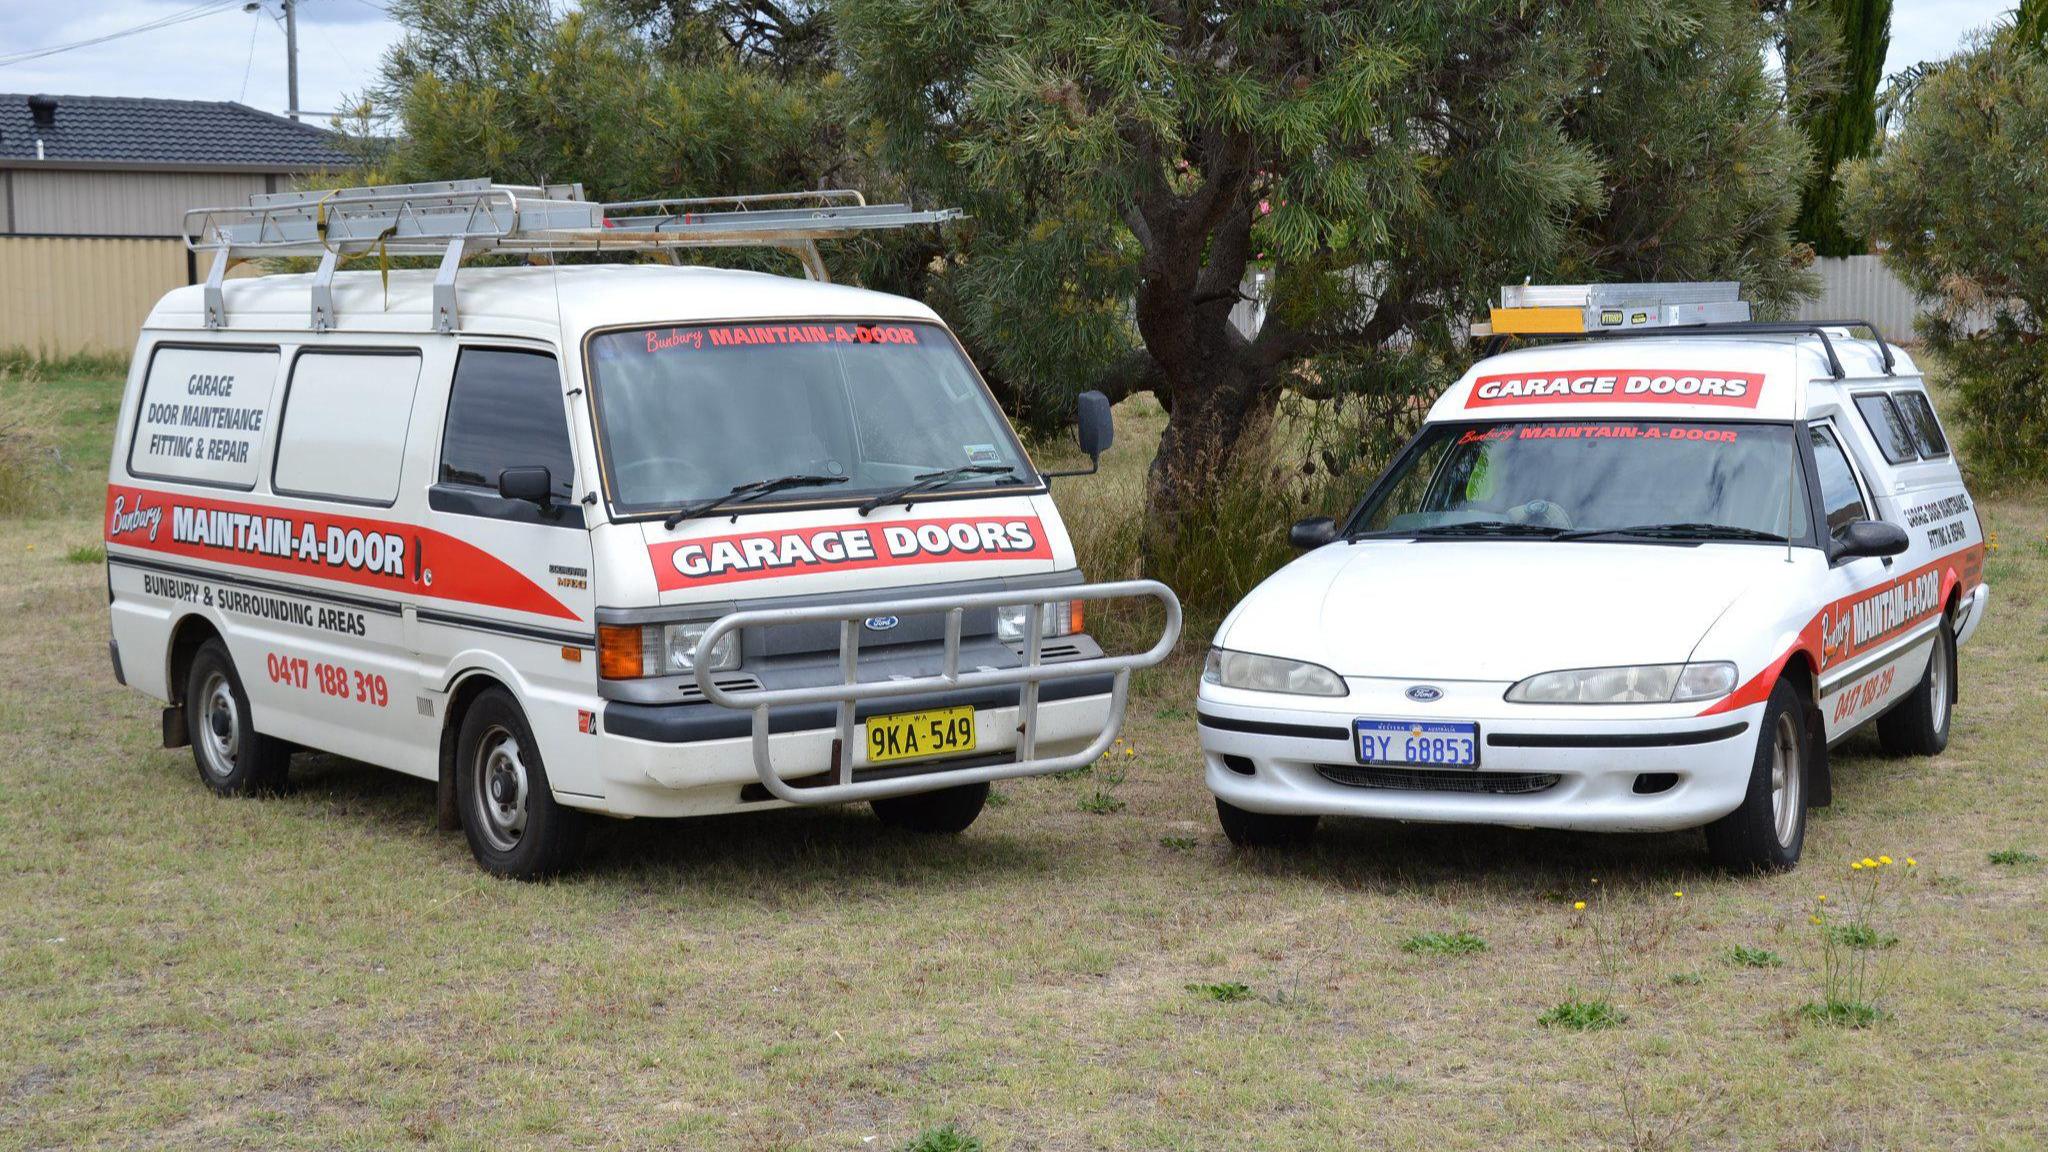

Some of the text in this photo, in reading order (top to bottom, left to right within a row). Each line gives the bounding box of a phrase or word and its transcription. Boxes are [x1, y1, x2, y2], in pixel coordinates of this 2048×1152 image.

[646, 326, 919, 352] Bunbury MAINTAIN-A-DOOR
[187, 374, 235, 398] GARAGE
[1477, 375, 1749, 400] GARAGE DOORS
[147, 402, 263, 432] DOOR MAINTENANCE
[149, 433, 250, 464] FITTING & REPAIR
[1457, 425, 1737, 445] Bunbury MAINTAIN-A-DOOR
[111, 494, 406, 578] Bunbury MAINTAIN-A-DOOR
[671, 521, 1035, 578] GARAGE DOORS
[144, 573, 366, 637] BUNBURY & SURROUNDING AREAS
[1853, 569, 1939, 648] MAINTAIN-A-DOOR
[267, 652, 388, 708] 0417 188 319
[1833, 683, 1861, 724] 0417
[1860, 674, 1880, 708] 188
[1361, 735, 1473, 765] BY 68853
